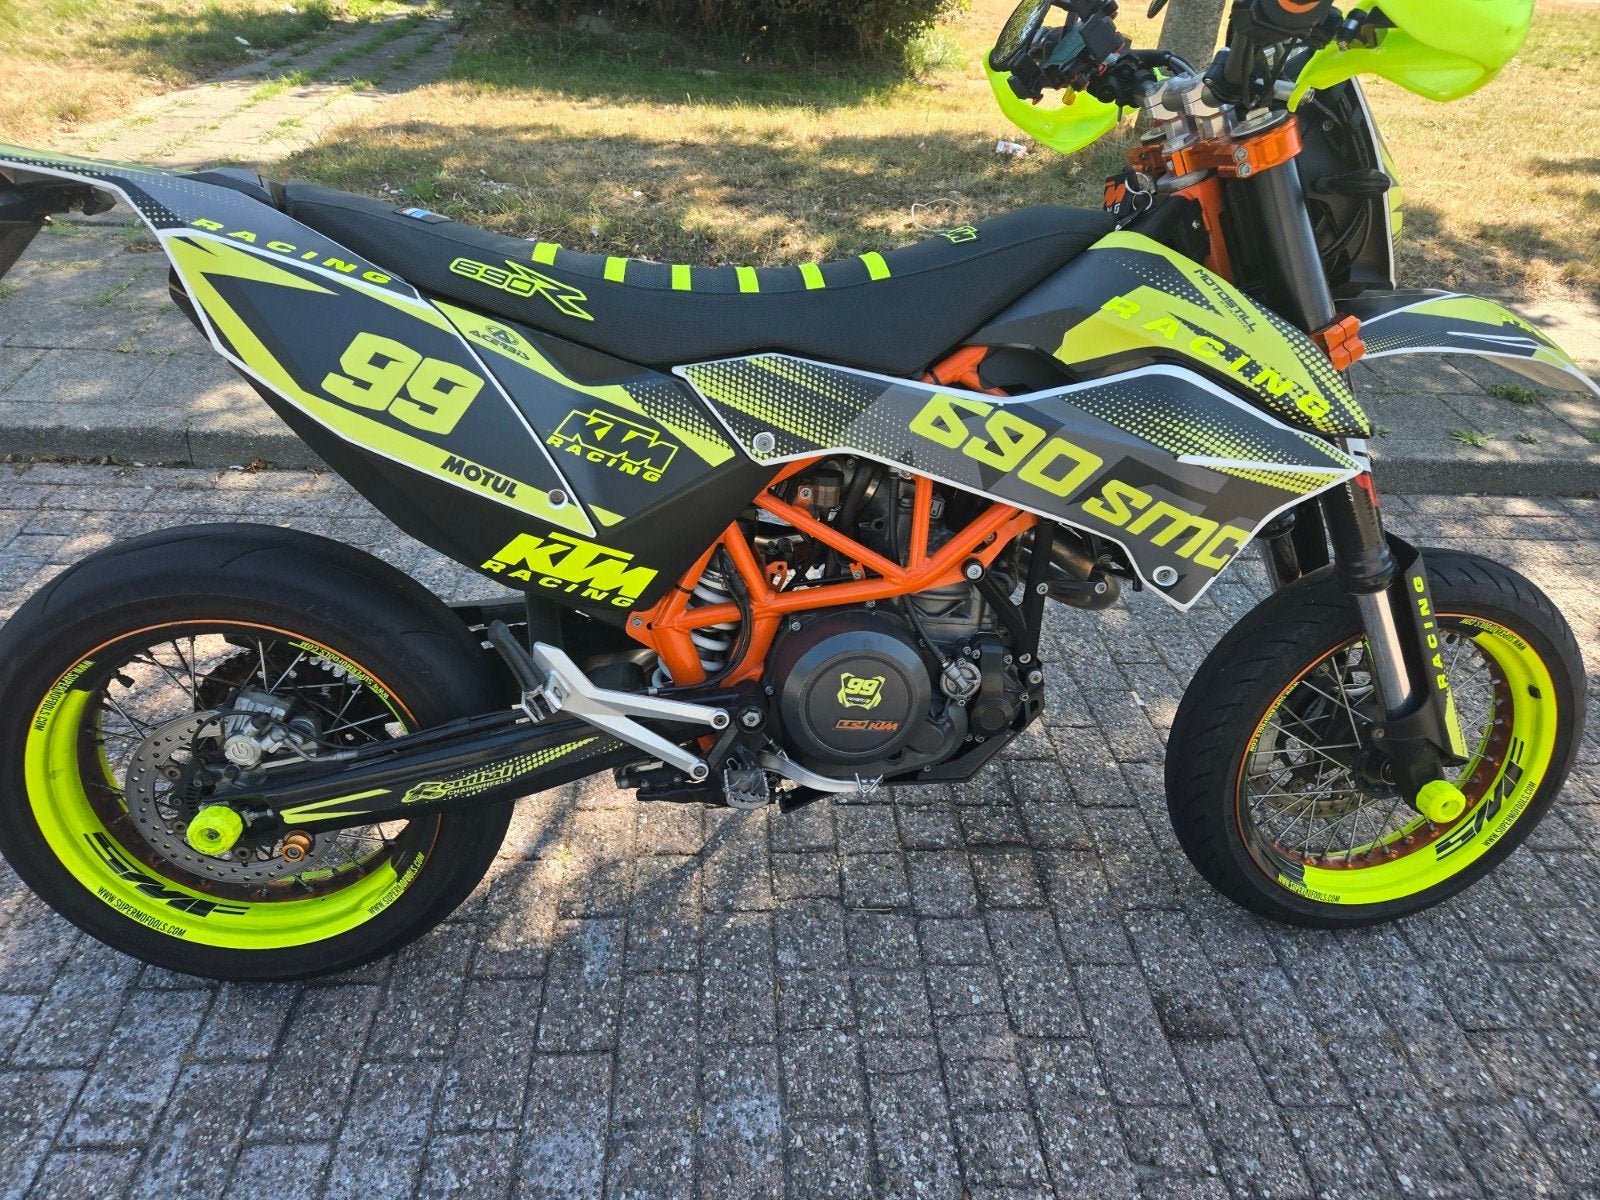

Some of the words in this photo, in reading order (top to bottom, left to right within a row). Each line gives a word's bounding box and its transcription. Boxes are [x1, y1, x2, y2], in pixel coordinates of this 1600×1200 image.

[191, 218, 392, 284] RACING
[1194, 269, 1256, 333] MOTOSTILL
[321, 332, 485, 435] 99
[1101, 296, 1331, 418] RACING
[546, 435, 661, 482] RACING
[553, 409, 679, 474] KTM
[909, 392, 1103, 497] 690
[441, 456, 517, 499] MOTUL
[480, 560, 634, 607] RACING
[492, 531, 659, 599] KTM
[1413, 576, 1449, 689] RACING
[845, 677, 880, 695] 99
[868, 722, 898, 731] KTM
[447, 778, 511, 796] CHAINWHEELS
[1482, 780, 1537, 847] WWW.SUPERMOFOOLS.COM
[97, 886, 187, 937] WWW.SUPERMOFOOLS.COM
